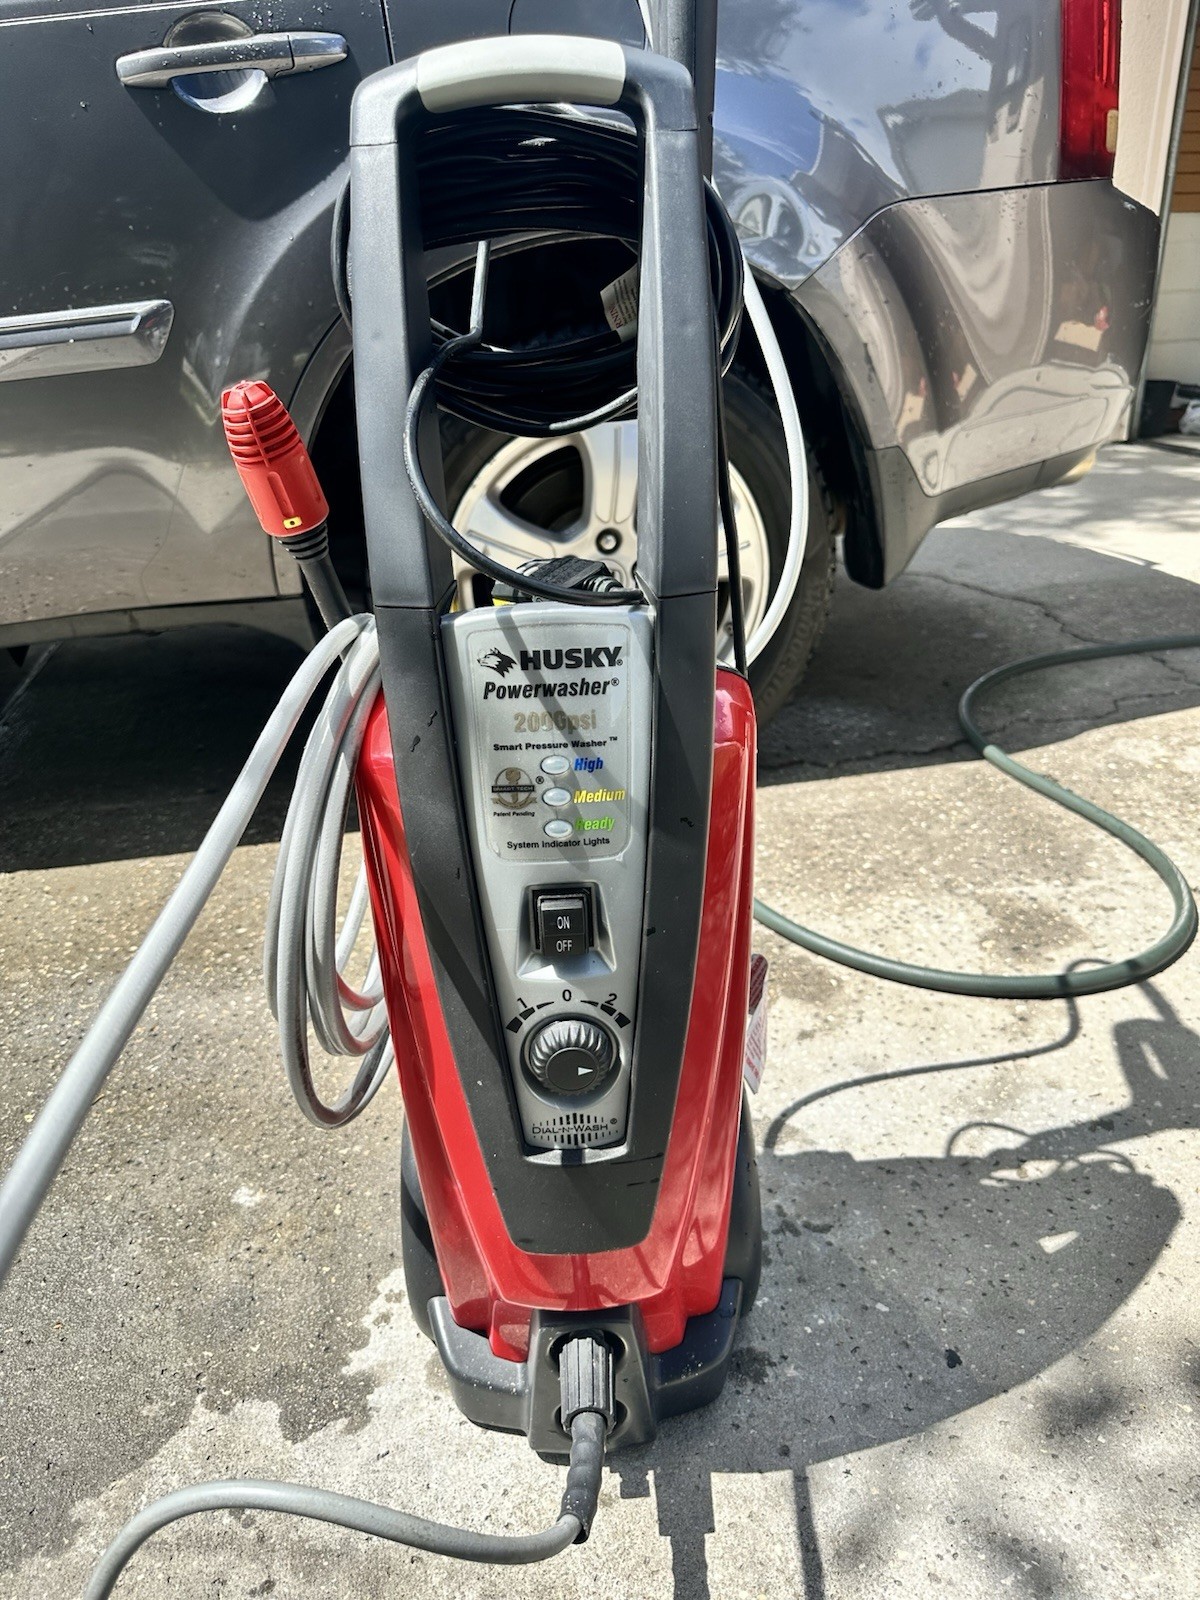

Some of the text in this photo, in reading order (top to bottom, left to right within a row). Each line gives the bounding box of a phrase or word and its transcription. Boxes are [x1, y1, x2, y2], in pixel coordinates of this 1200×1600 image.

[493, 743, 523, 751] Smart
[525, 742, 568, 750] Pressure
[574, 757, 604, 773] High
[574, 788, 625, 804] Medium
[575, 816, 615, 831] Ready
[507, 837, 610, 850] System Indicator Lights
[556, 916, 570, 929] ON
[556, 940, 572, 952] OFF
[517, 989, 617, 1008] 1 0 2
